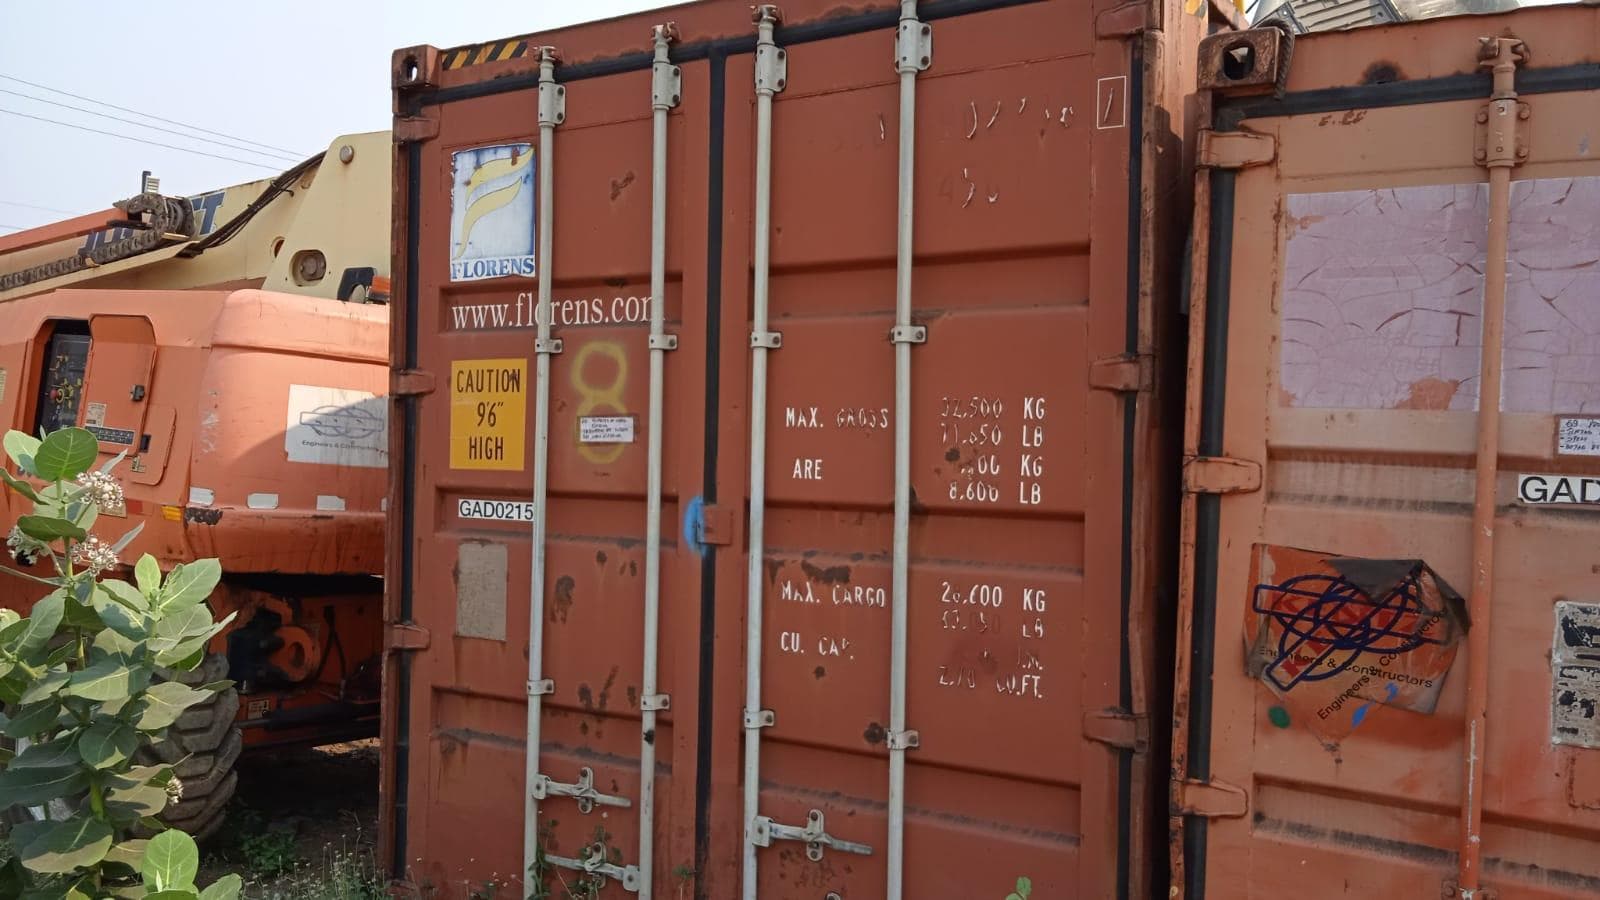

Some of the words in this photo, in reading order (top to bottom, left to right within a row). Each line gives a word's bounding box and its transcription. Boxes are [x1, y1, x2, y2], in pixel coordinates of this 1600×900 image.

[451, 257, 535, 280] FLORENS
[456, 368, 521, 394] CAUTION
[785, 407, 824, 429] MAX.
[1023, 397, 1045, 420] KG
[468, 436, 504, 461] HIGH
[1022, 425, 1043, 448] LB
[1020, 454, 1042, 477] KG
[1019, 481, 1041, 505] LB
[1520, 475, 1600, 503] GAD
[459, 500, 534, 520] GAD0215
[832, 584, 886, 608] CARGO
[1023, 587, 1045, 612] KG
[780, 631, 805, 654] CU.
[1316, 674, 1371, 721] Engineers
